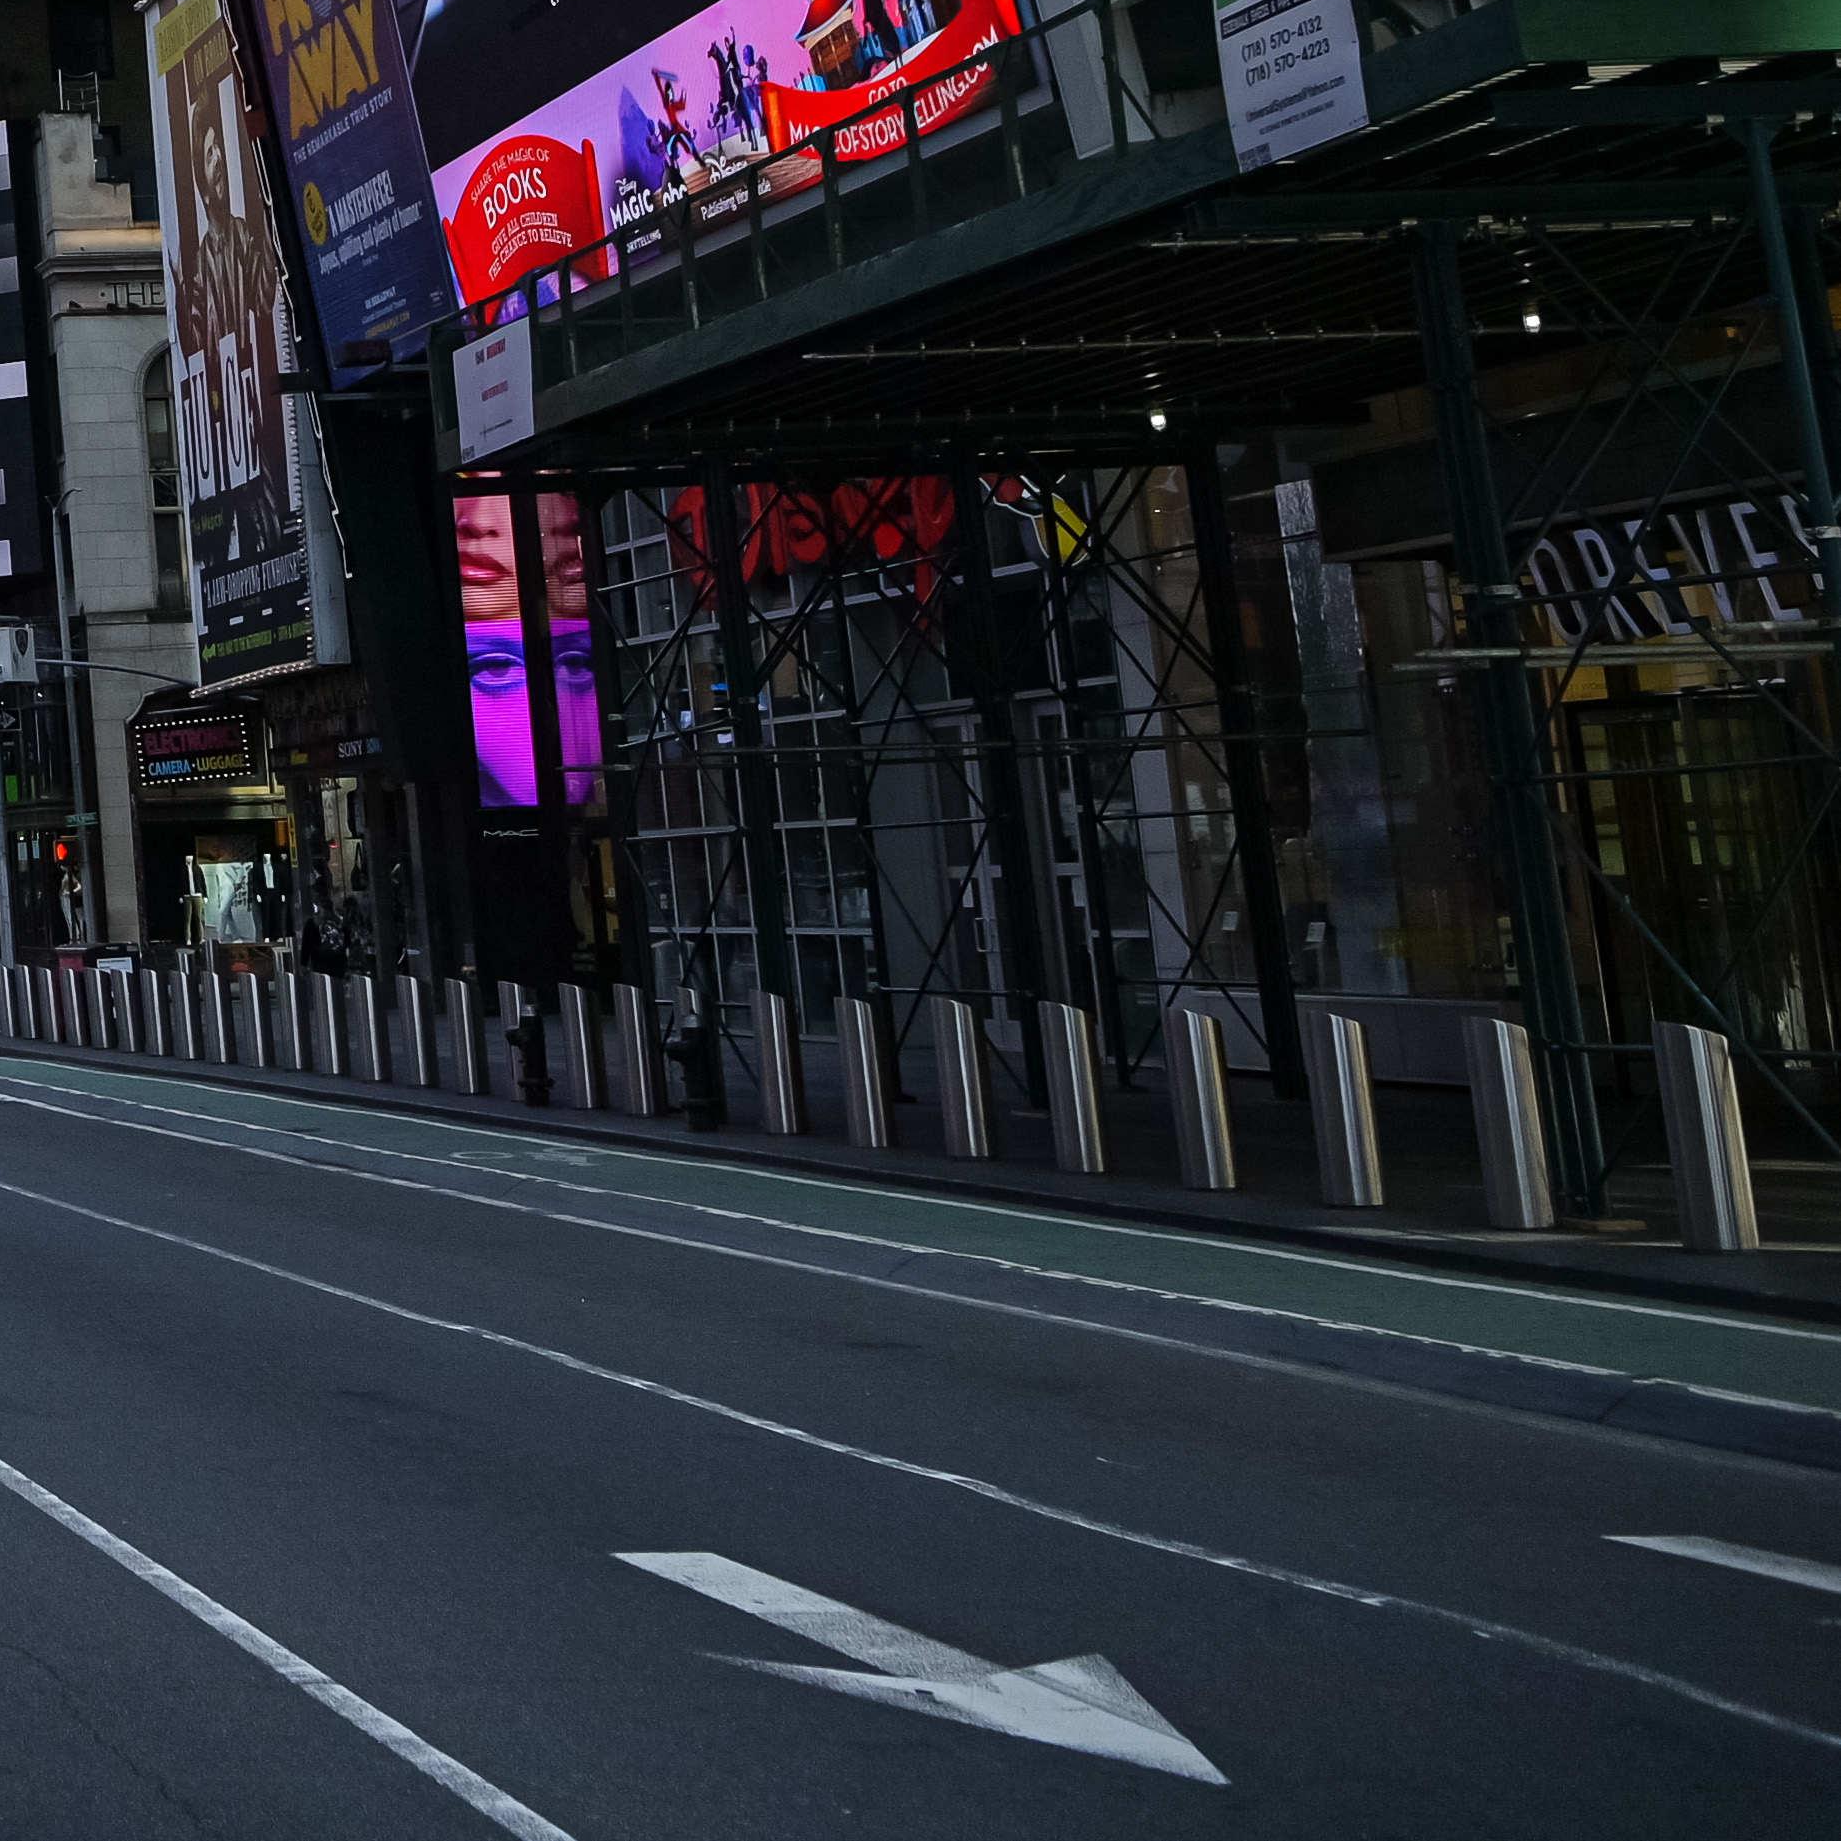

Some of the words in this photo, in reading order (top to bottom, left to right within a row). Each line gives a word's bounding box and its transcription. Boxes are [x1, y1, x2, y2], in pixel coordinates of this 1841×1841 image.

[1241, 37, 1267, 63] (718)
[1270, 16, 1323, 50] 570-4132
[1246, 62, 1271, 87] (718)
[1274, 38, 1331, 73] 570-4223
[306, 123, 350, 160] REMARKABLE
[349, 109, 369, 129] TRUE
[369, 86, 394, 115] STORY
[470, 173, 493, 207] SHARE
[492, 156, 507, 178] THE
[506, 147, 536, 163] MAGIC
[536, 147, 550, 163] OF
[482, 167, 547, 229] BOOKS
[610, 188, 654, 229] MAGIC
[487, 256, 504, 281] THE
[499, 231, 529, 266] CHANCE
[528, 229, 540, 244] TO
[539, 227, 573, 247] BELIEVE
[491, 225, 511, 254] GIVE
[508, 220, 521, 234] ALL
[519, 212, 559, 228] CHILDREN
[148, 759, 192, 777] CAMERA
[196, 753, 244, 773] LUGGAGE
[338, 739, 363, 758] SONY
